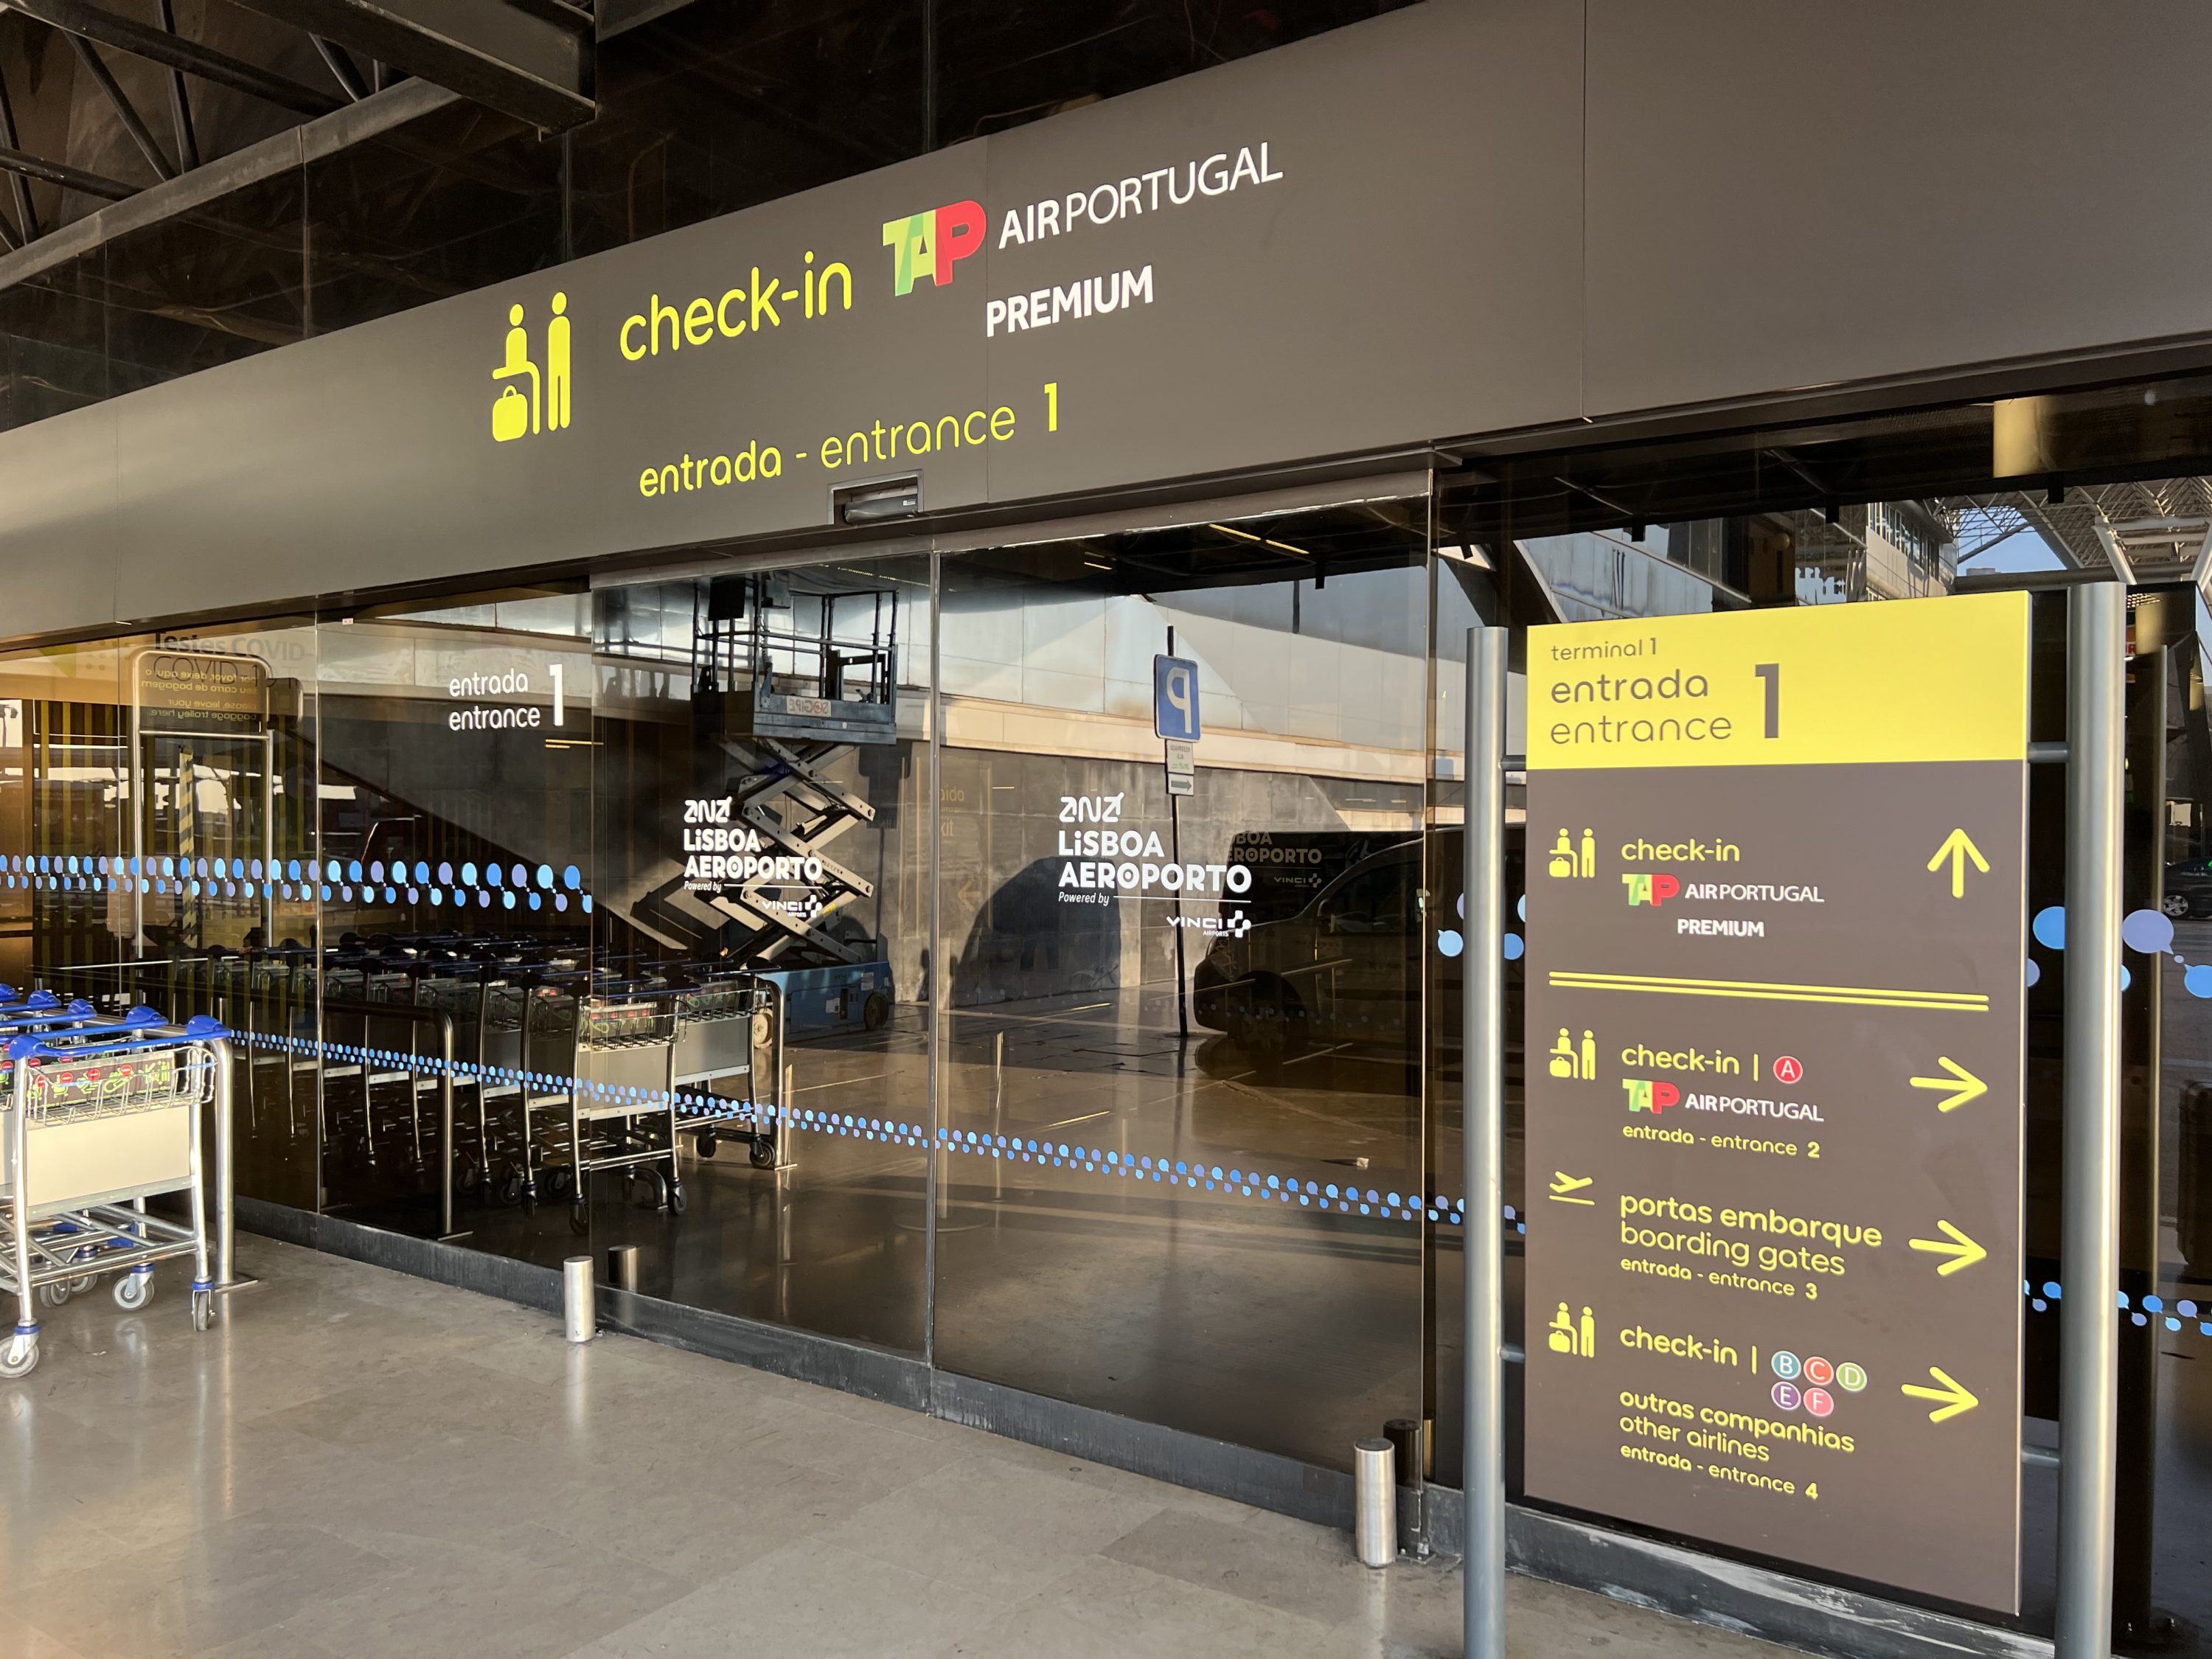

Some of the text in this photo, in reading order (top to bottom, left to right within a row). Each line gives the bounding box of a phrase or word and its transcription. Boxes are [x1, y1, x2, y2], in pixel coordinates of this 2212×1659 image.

[883, 200, 988, 297] TAP
[619, 251, 852, 361] check-in
[987, 265, 1153, 338] PREMIUM
[640, 440, 782, 498] entrada
[821, 406, 1016, 469] entrance
[1045, 382, 1058, 434] 1
[1551, 637, 1656, 661] terminal 1
[449, 667, 529, 698] entrada
[549, 664, 563, 726] 1
[1551, 668, 1708, 703] entrada
[449, 705, 540, 731] entrance
[1755, 663, 1779, 739] 1
[1550, 715, 1732, 745] entrance
[684, 855, 823, 880] AEROPORTO
[1621, 838, 1741, 862] check-in
[684, 880, 722, 893] Powered by
[1058, 861, 1252, 893] AEROPORTO
[1622, 874, 1680, 905] TAP
[762, 900, 803, 911] VINCI
[1058, 891, 1110, 906] Powered by
[1166, 916, 1223, 929] VINCI
[1677, 919, 1764, 937] PREMIUM
[1621, 1043, 1740, 1074] check-in
[1781, 1060, 1795, 1079] A
[1622, 1078, 1680, 1114] TAP
[1622, 1125, 1694, 1144] entrada
[1711, 1135, 1798, 1155] entrance
[1807, 1141, 1820, 1158] 2
[1621, 1195, 1882, 1248] portas embarque
[1621, 1220, 1846, 1276] boarding gates
[1621, 1258, 1692, 1280] entrada
[1708, 1271, 1795, 1296] entrance
[1805, 1282, 1818, 1300] 3
[1620, 1326, 1738, 1366] check-in
[1779, 1354, 1793, 1374] B
[1810, 1361, 1826, 1380] C
[1845, 1366, 1861, 1385] D
[1780, 1385, 1825, 1410] E F
[1620, 1391, 1855, 1453] outras companhias
[1620, 1416, 1770, 1462] other airlines
[1620, 1444, 1692, 1472] entrada
[1708, 1464, 1795, 1494] entrance
[1804, 1482, 1818, 1500] 4
